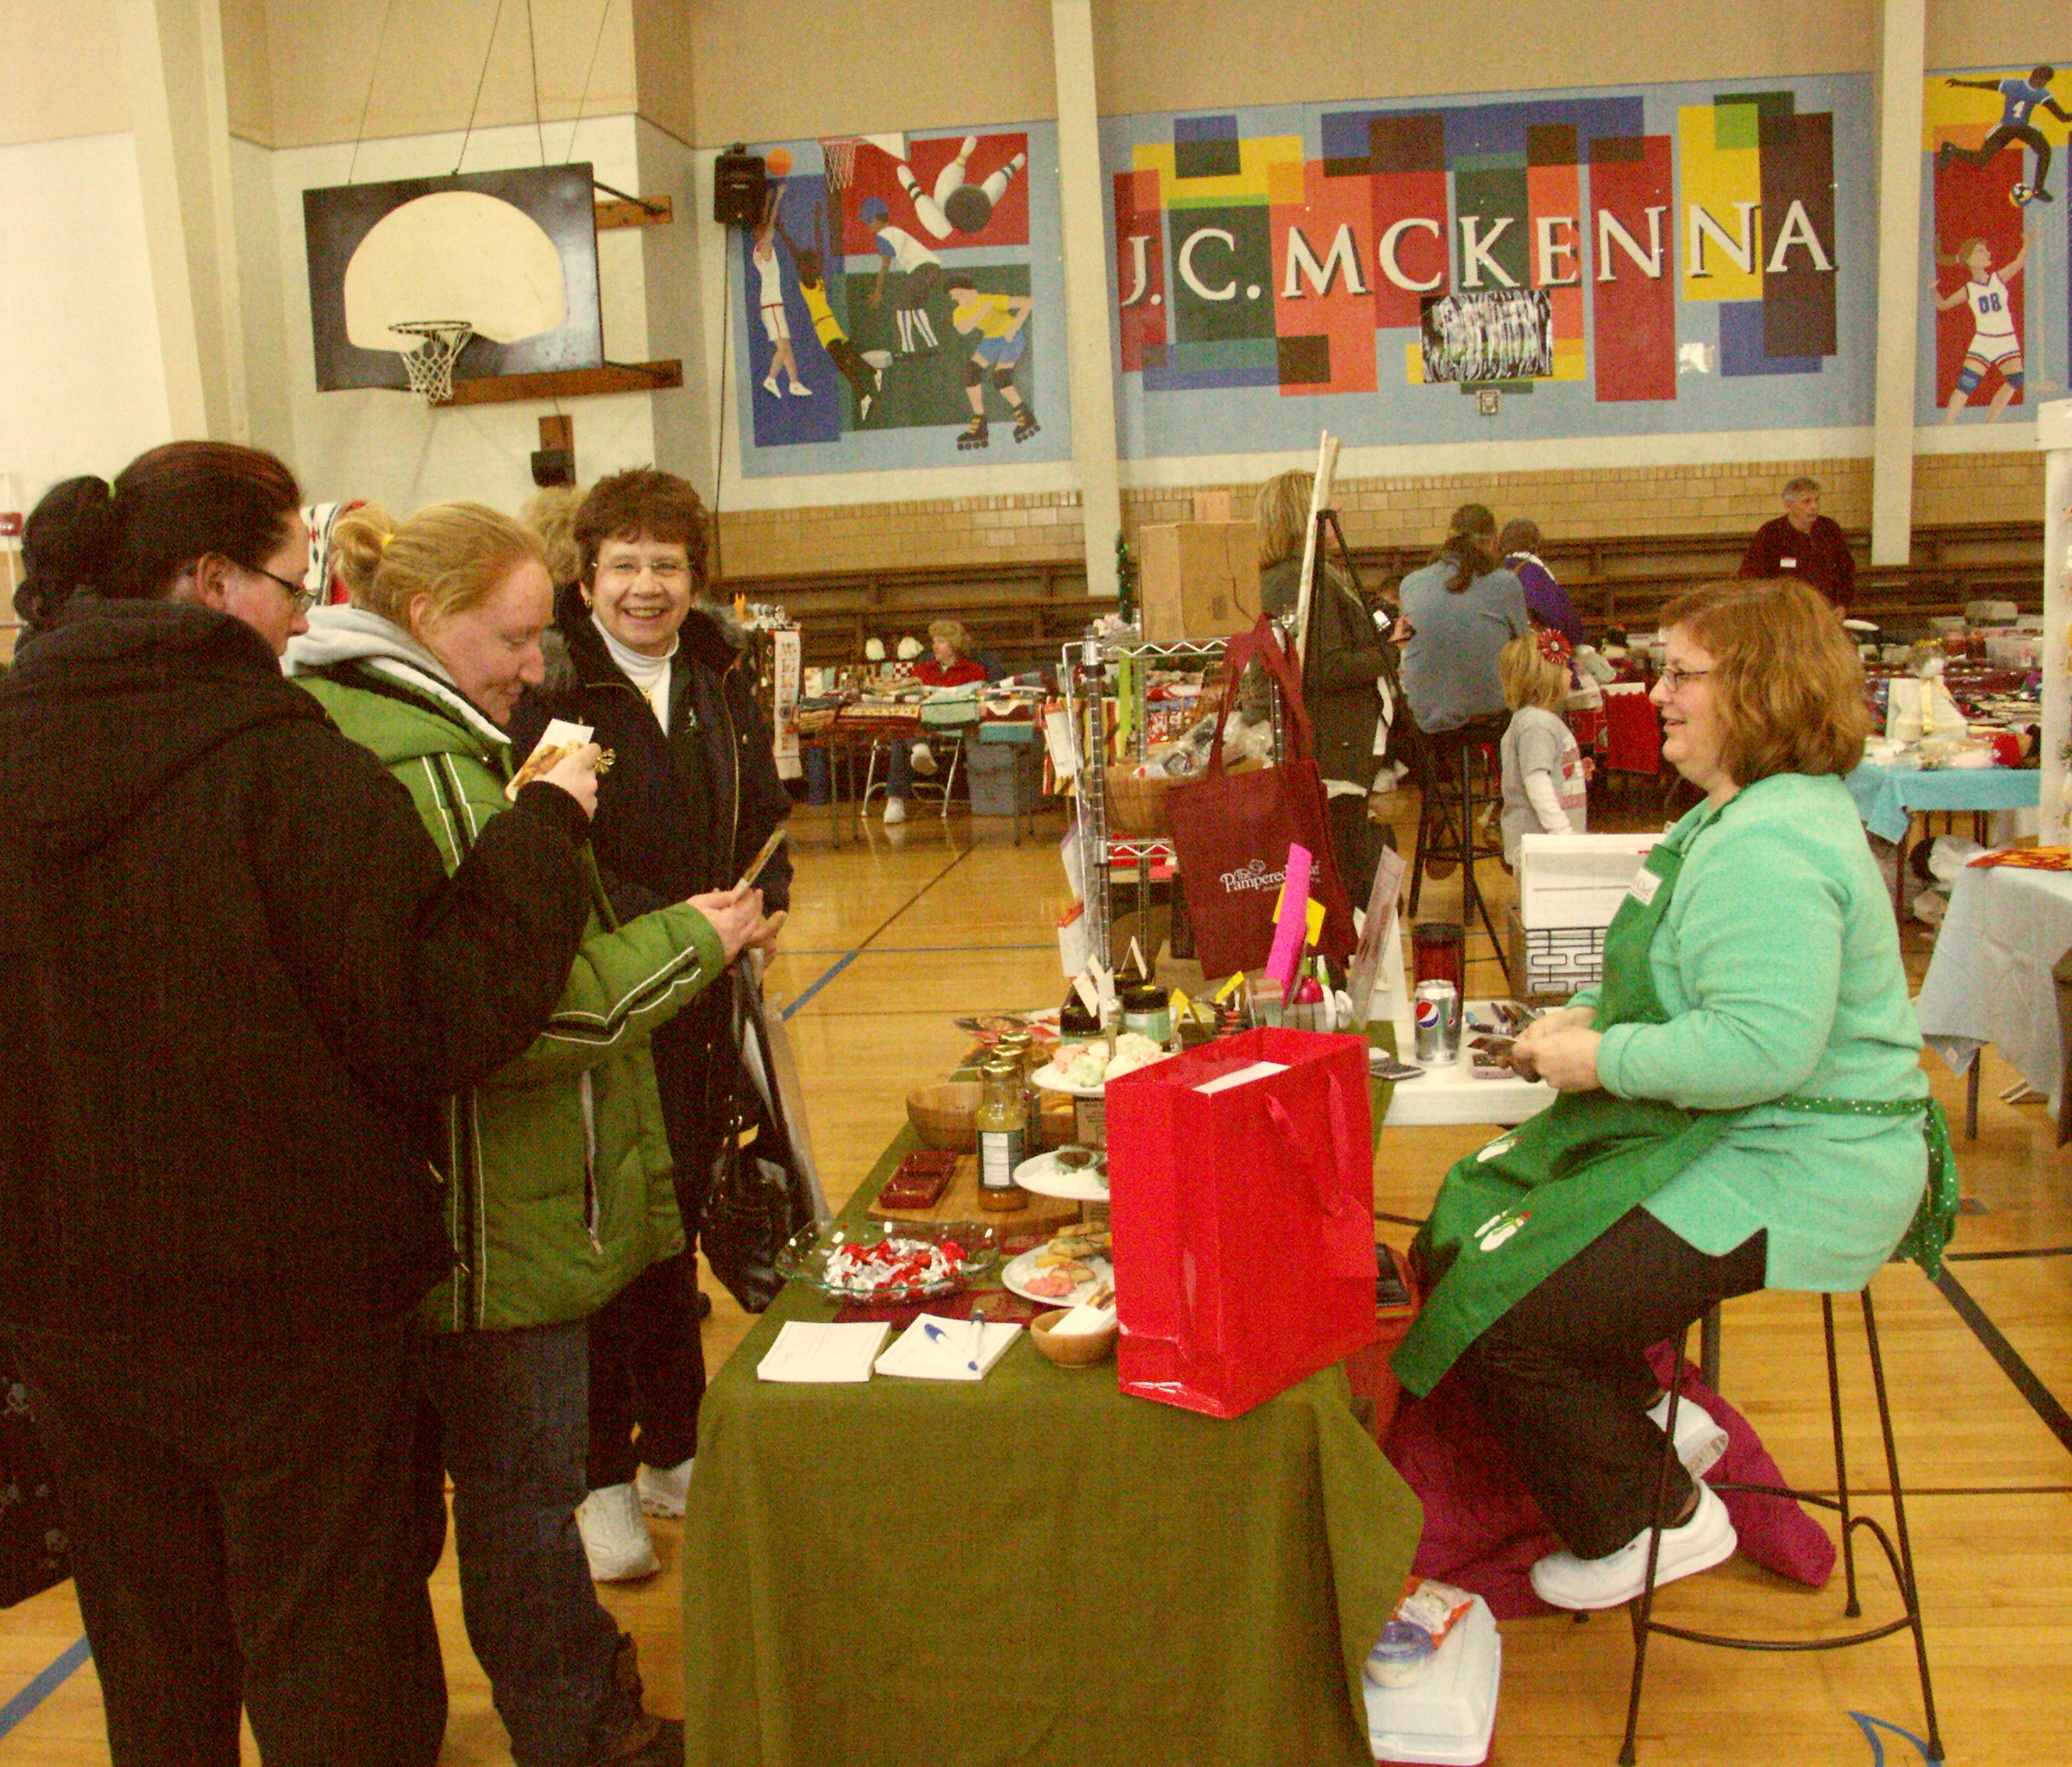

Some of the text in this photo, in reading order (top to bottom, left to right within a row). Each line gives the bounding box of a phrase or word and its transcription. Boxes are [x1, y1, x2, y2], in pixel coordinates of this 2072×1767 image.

[2011, 100, 2025, 118] 4
[1121, 199, 1833, 307] J.C. MCKENNA
